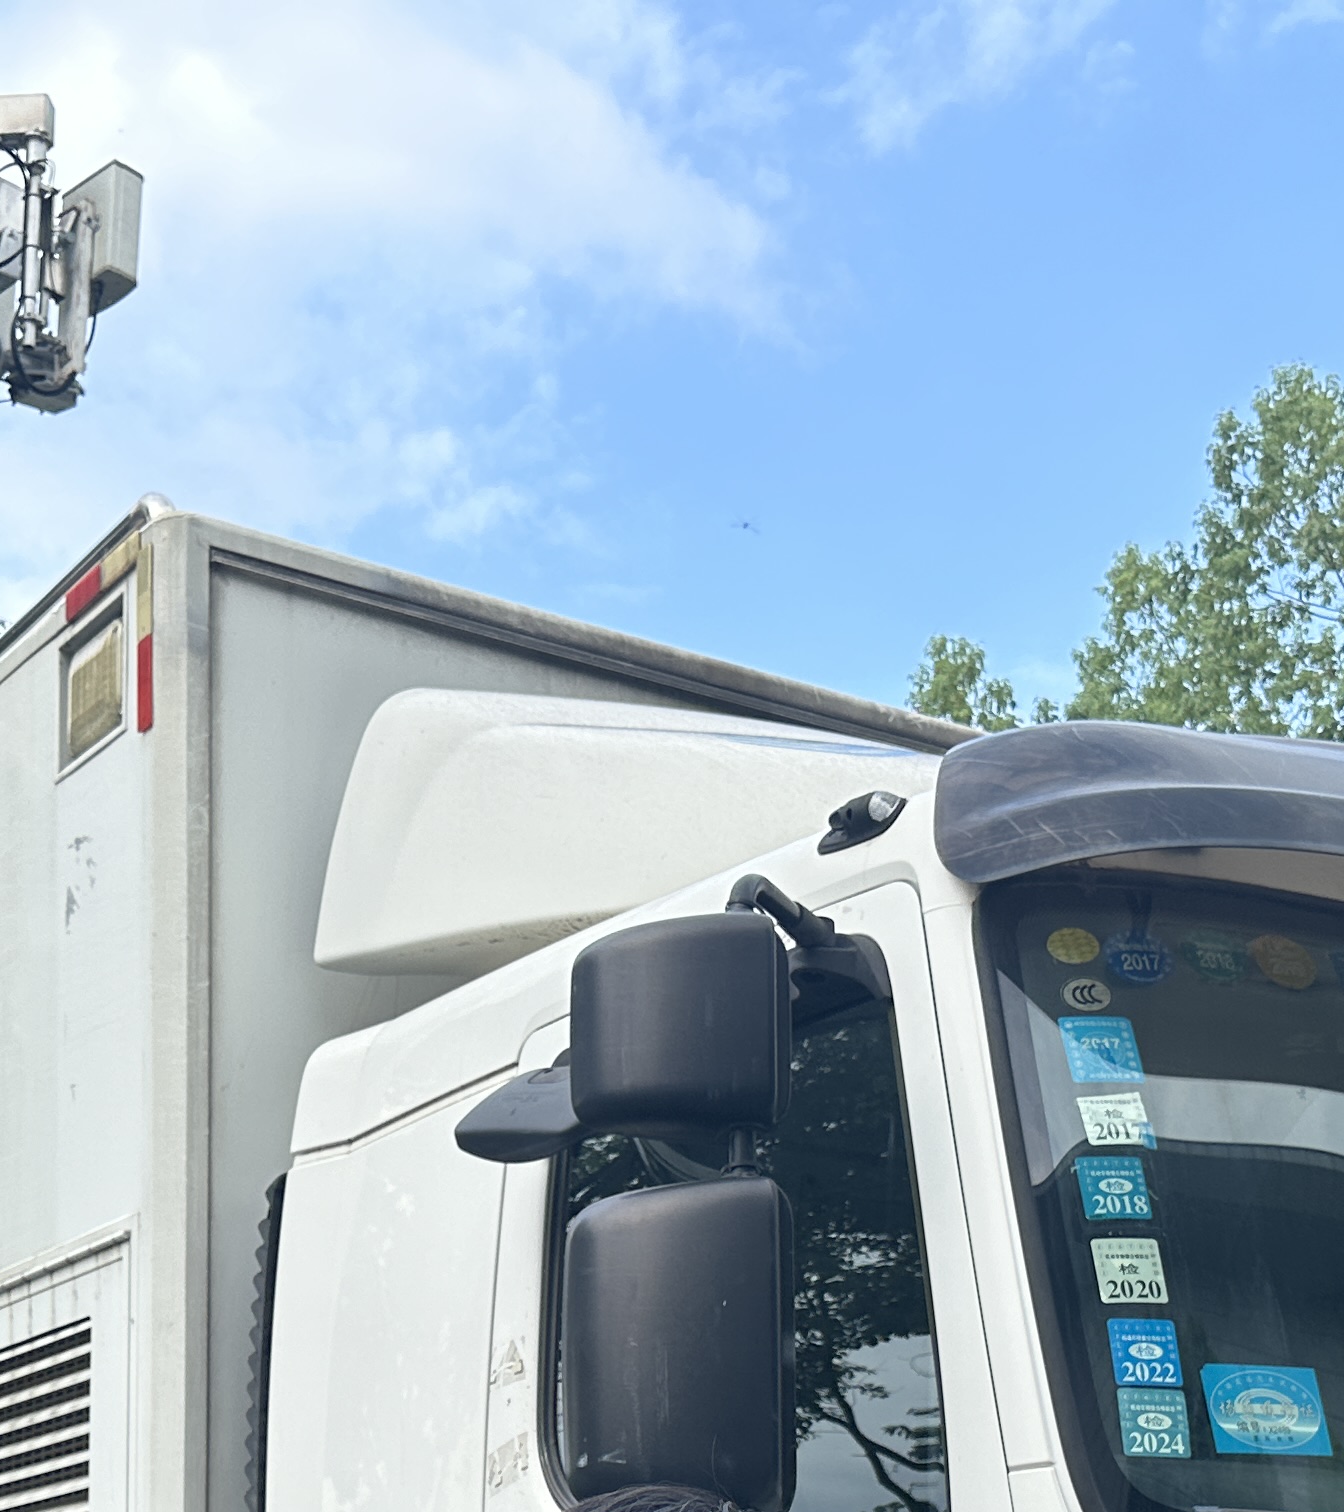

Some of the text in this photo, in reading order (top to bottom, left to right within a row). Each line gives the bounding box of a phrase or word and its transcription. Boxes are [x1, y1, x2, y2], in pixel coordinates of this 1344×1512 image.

[1121, 953, 1161, 971] 2017
[1093, 1122, 1146, 1141] 2017
[1092, 1195, 1149, 1215] 2018
[1106, 1279, 1162, 1299] 2020
[1121, 1361, 1177, 1383] 2022
[1129, 1432, 1185, 1454] 2024
